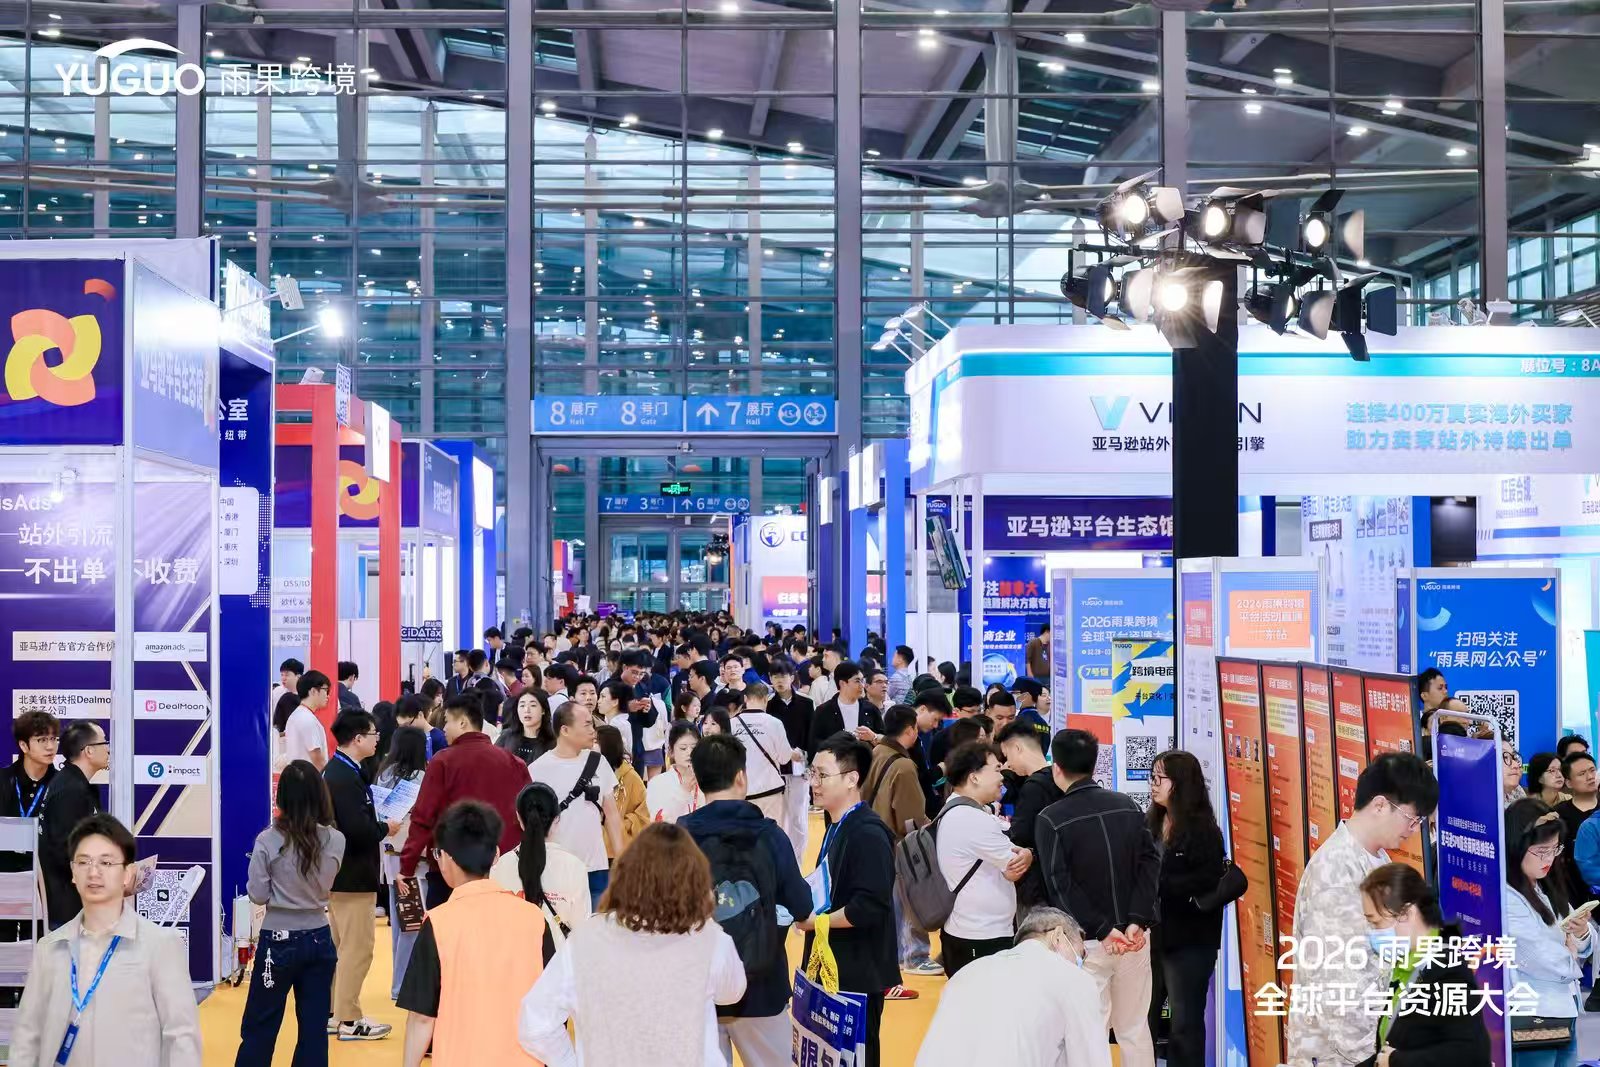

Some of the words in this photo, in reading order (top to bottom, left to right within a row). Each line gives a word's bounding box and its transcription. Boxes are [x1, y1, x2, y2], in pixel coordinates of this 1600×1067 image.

[550, 401, 566, 425] 8
[571, 402, 598, 416] 展厅
[621, 401, 637, 425] 8
[640, 402, 668, 416] 号门
[725, 401, 741, 425] 7
[746, 402, 774, 416] 展厅
[0, 493, 52, 513] sAds
[604, 497, 613, 510] 7
[640, 497, 648, 510] 3
[696, 497, 705, 510] 6
[18, 523, 114, 546] 站外引流
[25, 558, 107, 585] 不出单
[1081, 615, 1159, 628] 2026雨果跨境
[1455, 631, 1518, 647] 扫码关注
[145, 645, 172, 653] amazon
[158, 702, 205, 710] DealMoon
[173, 766, 201, 776] impact
